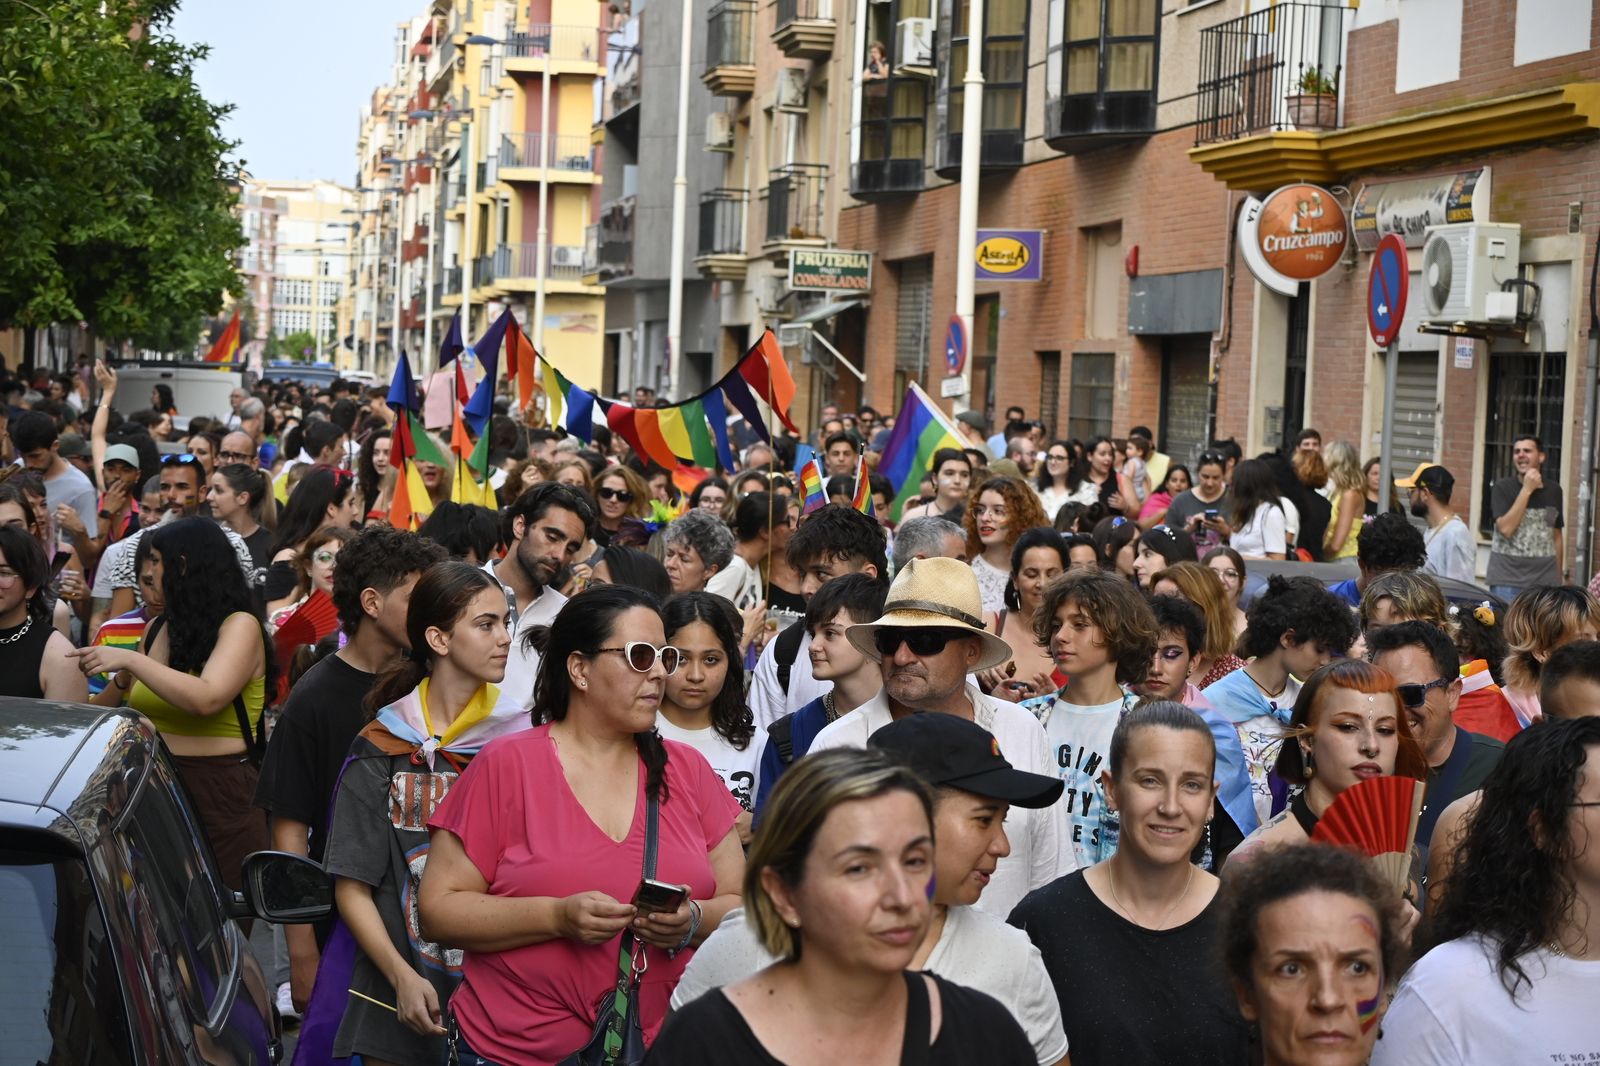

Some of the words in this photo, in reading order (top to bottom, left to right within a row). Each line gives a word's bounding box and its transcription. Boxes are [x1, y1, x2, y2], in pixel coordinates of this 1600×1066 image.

[1263, 231, 1343, 252] Cruzcampo
[795, 251, 868, 268] FRUTERIA
[794, 273, 867, 288] CONGELADOS
